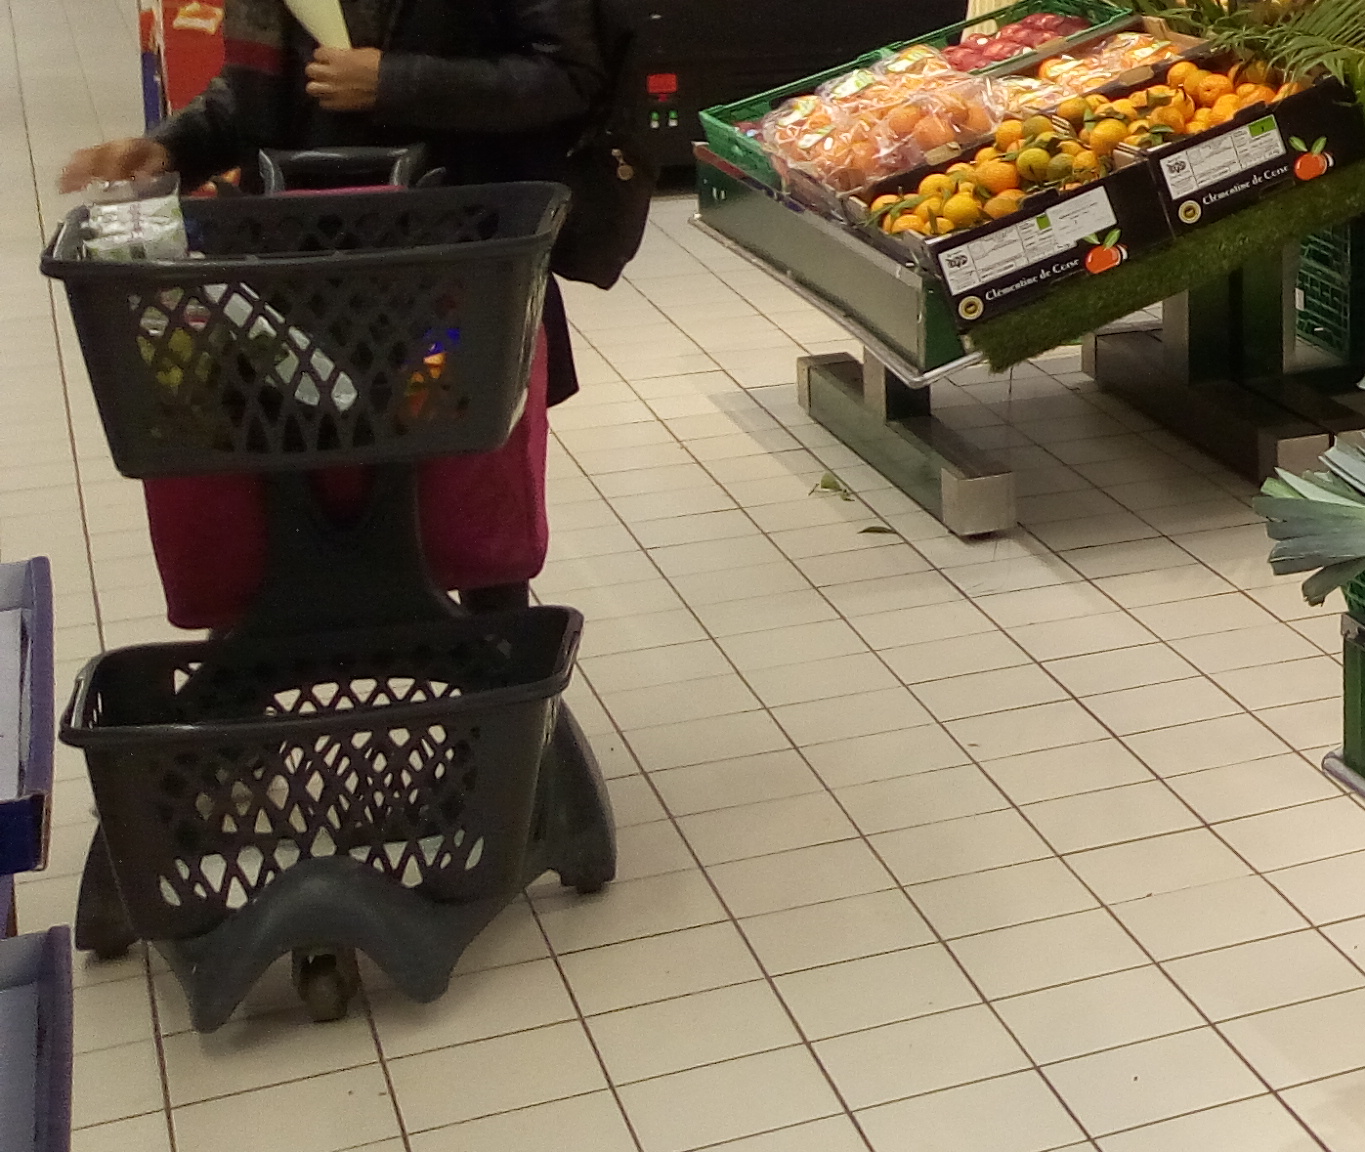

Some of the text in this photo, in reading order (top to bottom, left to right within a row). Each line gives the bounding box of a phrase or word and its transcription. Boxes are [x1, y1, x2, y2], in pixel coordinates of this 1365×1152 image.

[1251, 174, 1263, 186] de
[1263, 164, 1290, 180] Corse
[1039, 268, 1051, 280] de
[1052, 258, 1080, 275] Corse
